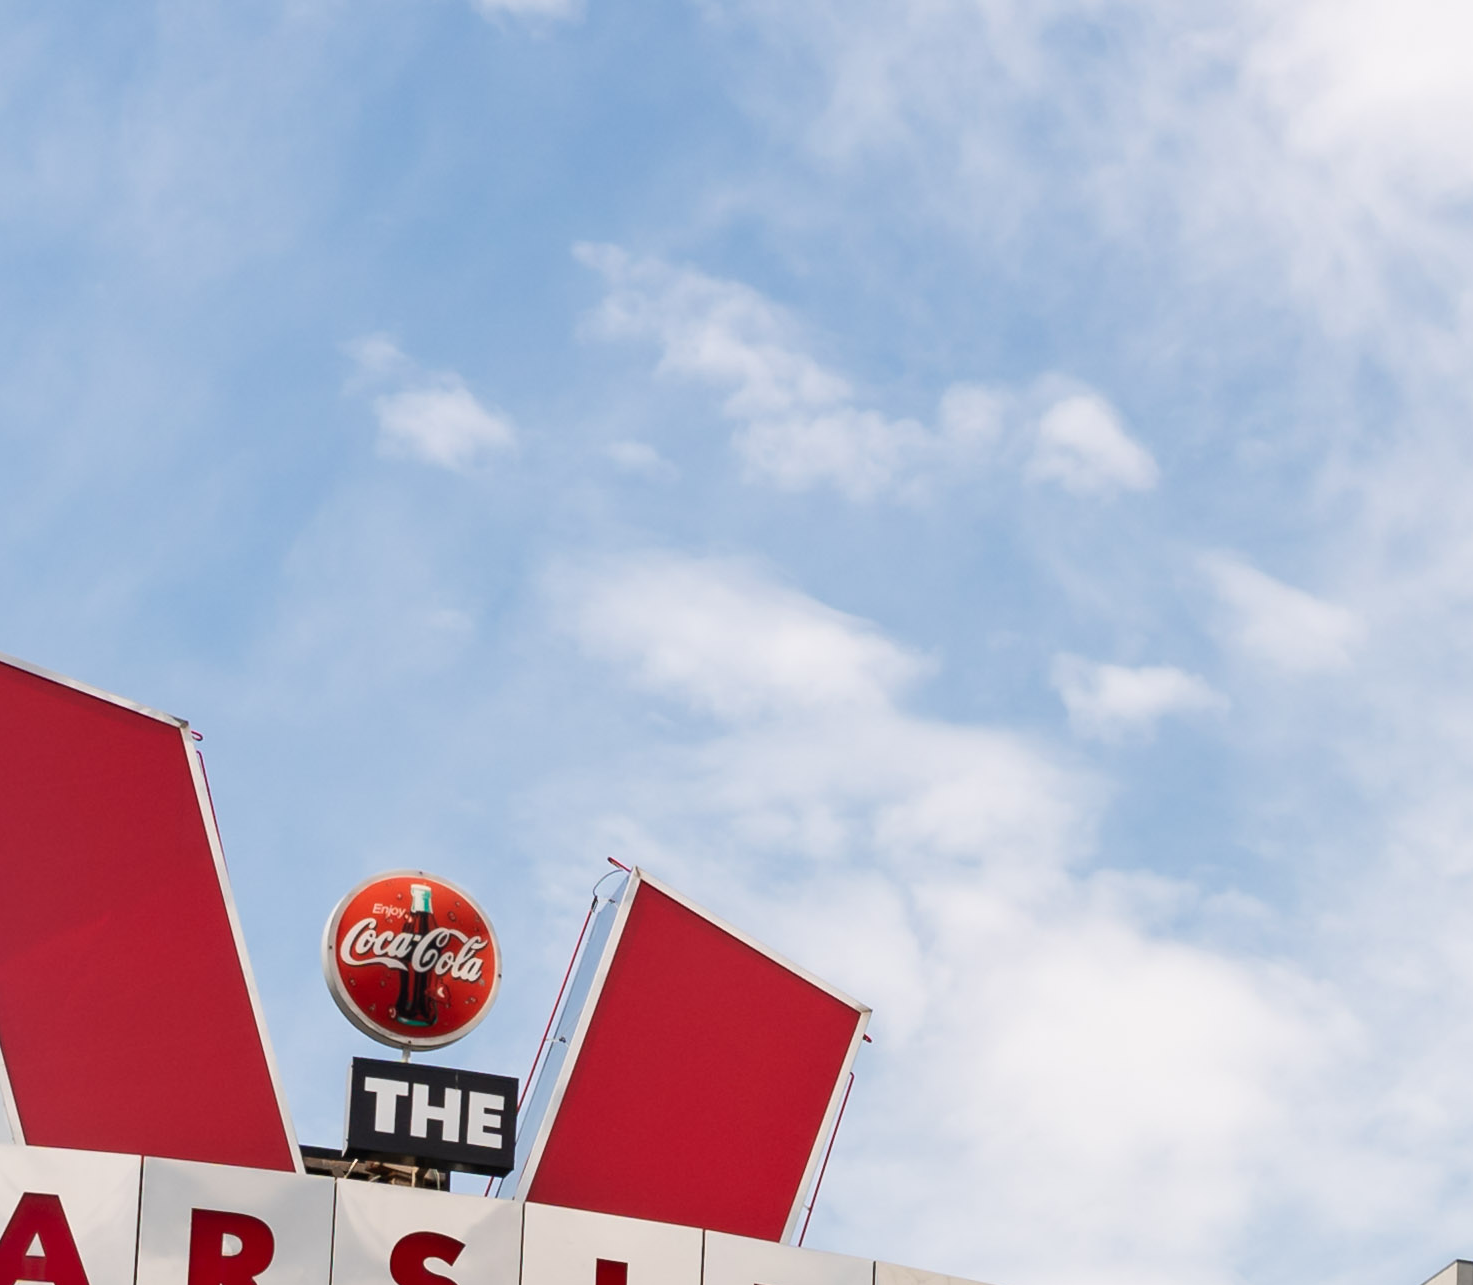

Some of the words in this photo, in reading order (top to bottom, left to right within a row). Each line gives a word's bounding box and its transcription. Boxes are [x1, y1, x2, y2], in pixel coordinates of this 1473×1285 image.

[372, 903, 406, 919] Enjoy
[341, 917, 488, 982] Coca-Cola
[364, 1076, 505, 1149] THE
